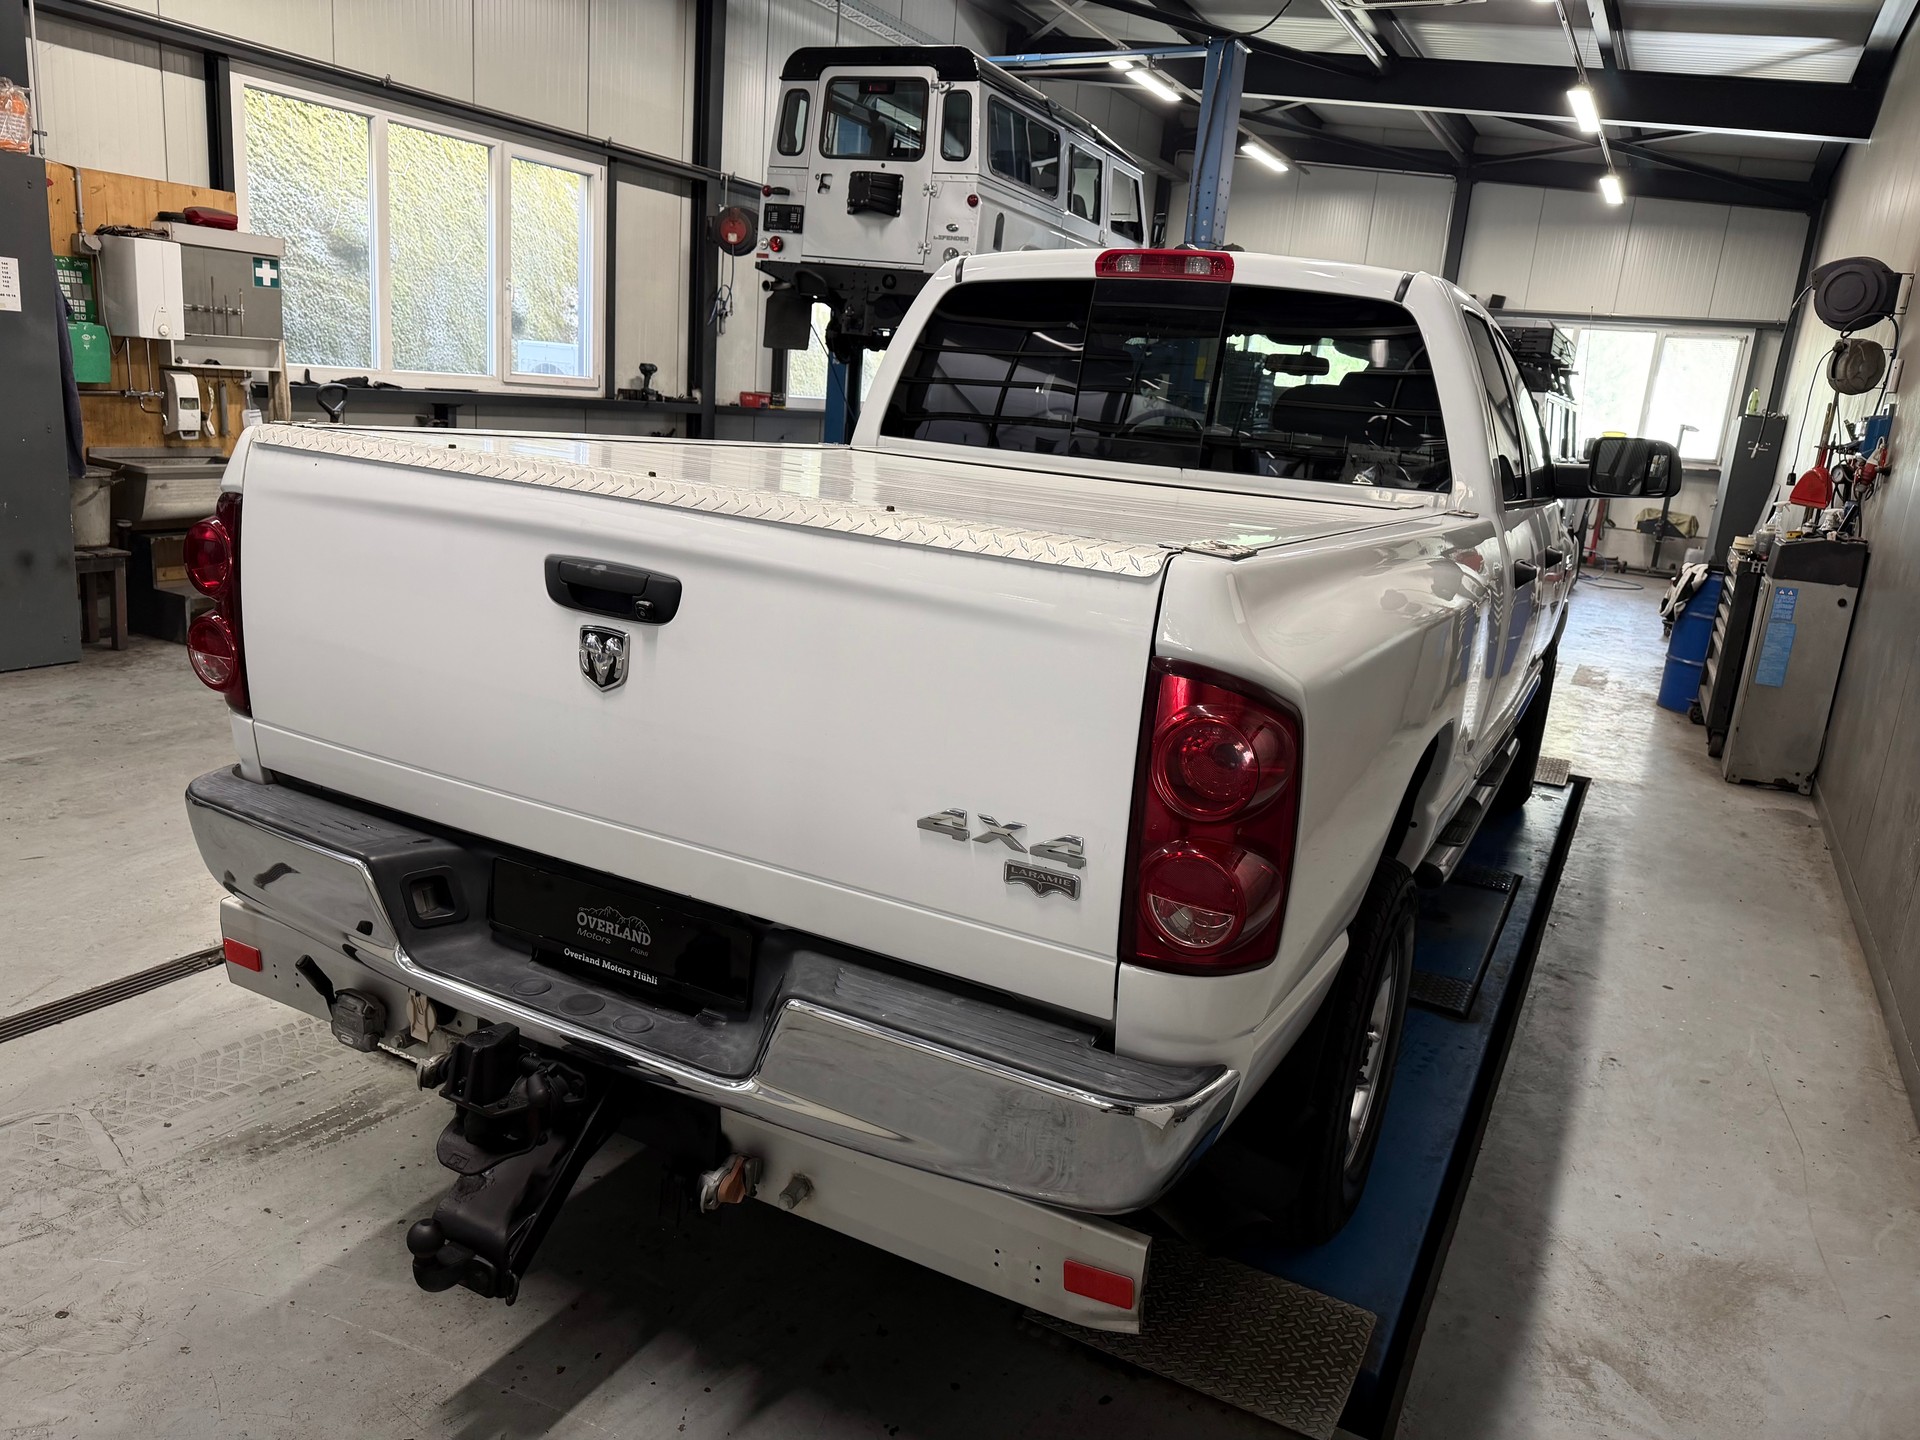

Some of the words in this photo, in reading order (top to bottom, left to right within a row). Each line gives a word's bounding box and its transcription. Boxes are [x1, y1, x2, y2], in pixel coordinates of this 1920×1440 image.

[1011, 866, 1071, 887] LARAMIE
[577, 912, 651, 946] OVERLAND
[577, 928, 611, 944] Motors
[563, 947, 600, 966] Overland
[601, 959, 631, 976] Motors
[633, 969, 658, 985] Flühli
